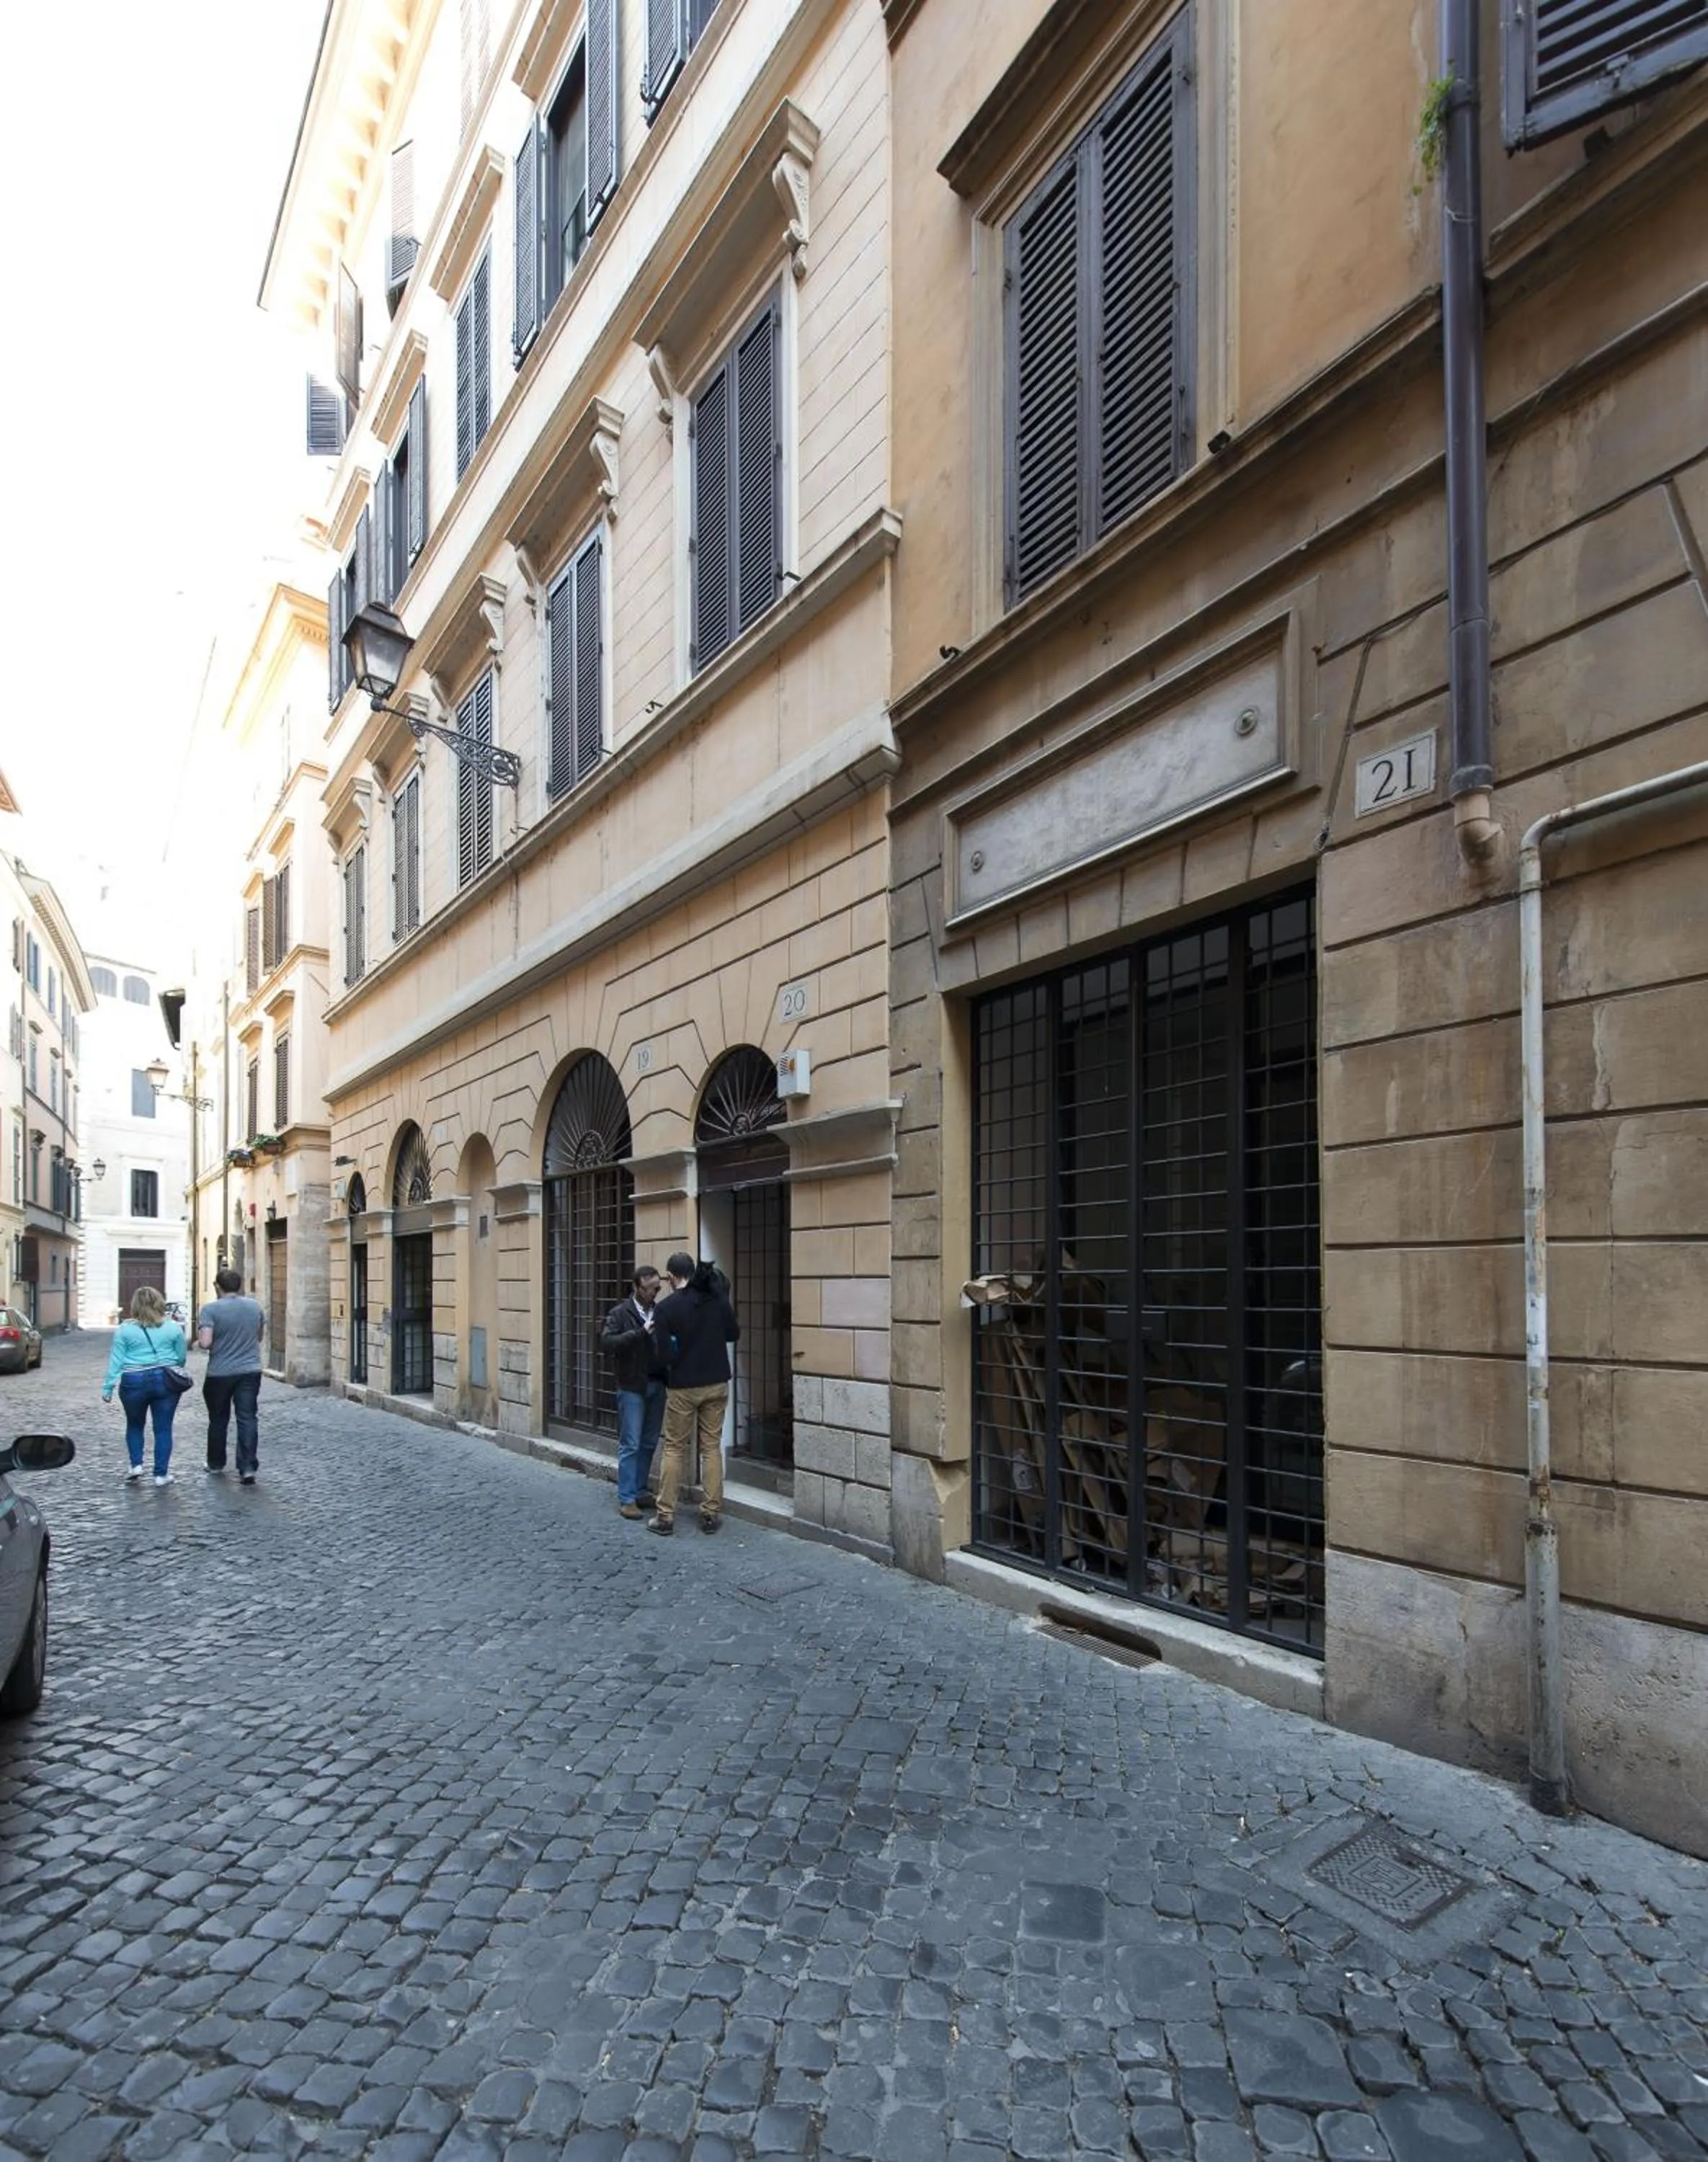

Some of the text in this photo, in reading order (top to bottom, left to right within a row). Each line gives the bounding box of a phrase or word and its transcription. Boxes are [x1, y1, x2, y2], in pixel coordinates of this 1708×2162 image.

[1371, 748, 1417, 804] 21
[783, 989, 805, 1017] 20
[637, 1049, 649, 1069] 19
